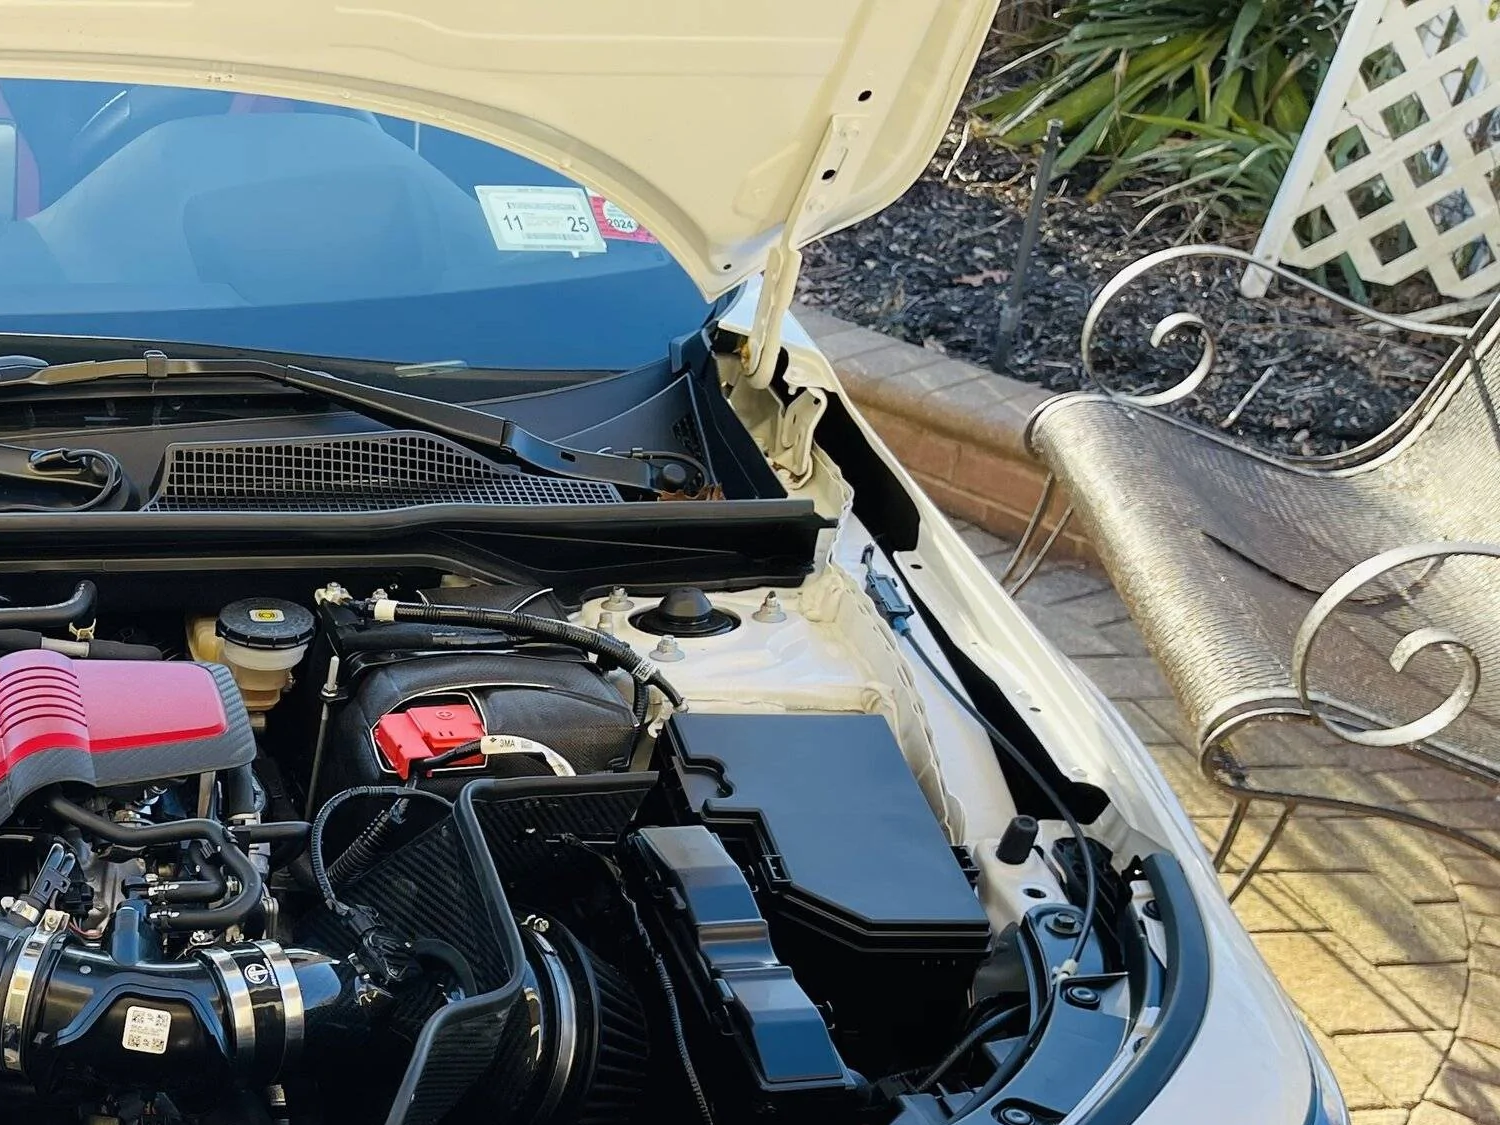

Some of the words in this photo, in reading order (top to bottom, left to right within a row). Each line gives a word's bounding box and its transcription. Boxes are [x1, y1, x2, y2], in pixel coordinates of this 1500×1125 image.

[503, 214, 523, 231] 11
[567, 216, 590, 233] 25
[606, 218, 633, 229] 2024
